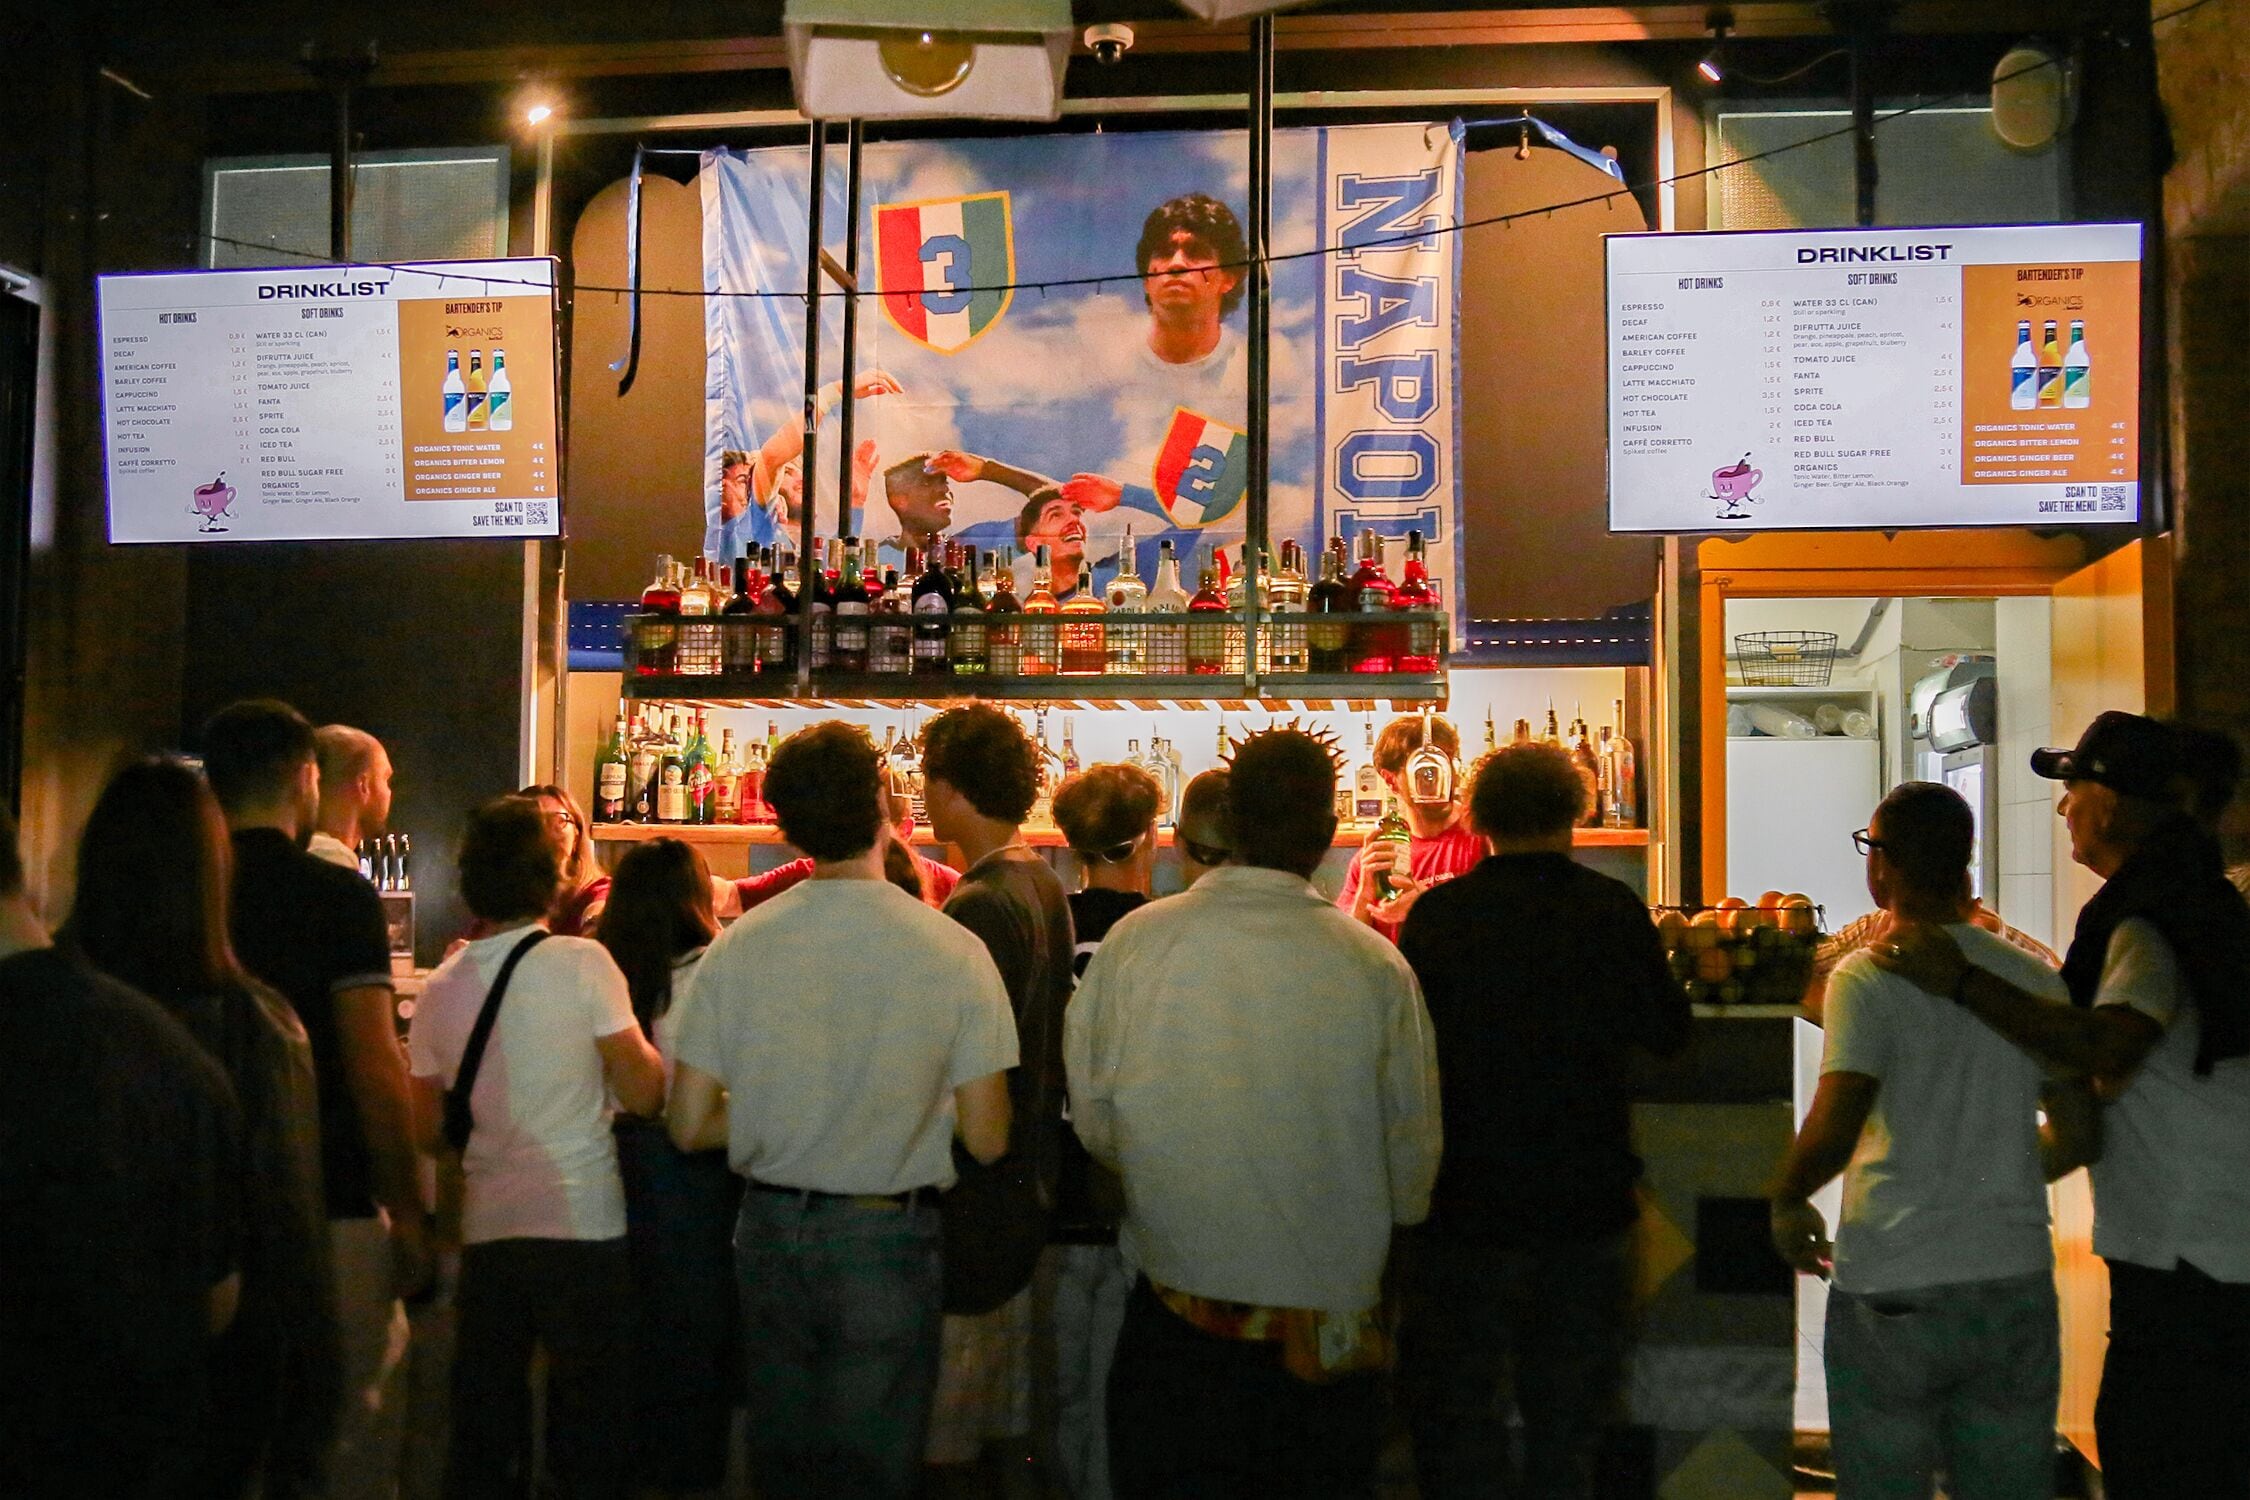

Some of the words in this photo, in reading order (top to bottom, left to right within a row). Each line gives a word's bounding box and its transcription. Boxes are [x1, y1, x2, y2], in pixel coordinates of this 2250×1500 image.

[1798, 245, 1953, 263] DRINKLIST
[917, 233, 974, 315] 3
[1848, 274, 1867, 285] SOFT
[1869, 273, 1898, 284] DRINKS
[2017, 269, 2069, 281] BARTENDER'S
[2072, 268, 2084, 280] TIP
[1678, 278, 1693, 289] HOT
[1695, 277, 1723, 288] DRINKS
[258, 282, 389, 299] DRINKLIST
[446, 303, 490, 314] BARTENDER'S
[492, 302, 502, 312] TIP
[1853, 298, 1878, 306] (CAN)
[159, 313, 171, 323] HOT
[173, 312, 197, 323] DRINKS
[301, 308, 318, 319] SOFT
[320, 307, 343, 318] DRINKS
[1832, 355, 1856, 363] JUICE
[1334, 165, 1443, 603] NAPOL
[1975, 424, 2017, 432] ORGANICS
[1178, 444, 1228, 495] 2
[2066, 486, 2085, 498] SCAN
[2087, 486, 2097, 497] TO
[495, 502, 513, 513] SCAN
[514, 502, 523, 512] TO
[2039, 501, 2058, 513] SAVE
[2060, 501, 2074, 512] THE
[2076, 500, 2097, 511] MENU
[473, 516, 489, 526] SAVE
[491, 516, 503, 526] THE
[505, 515, 523, 525] MENU
